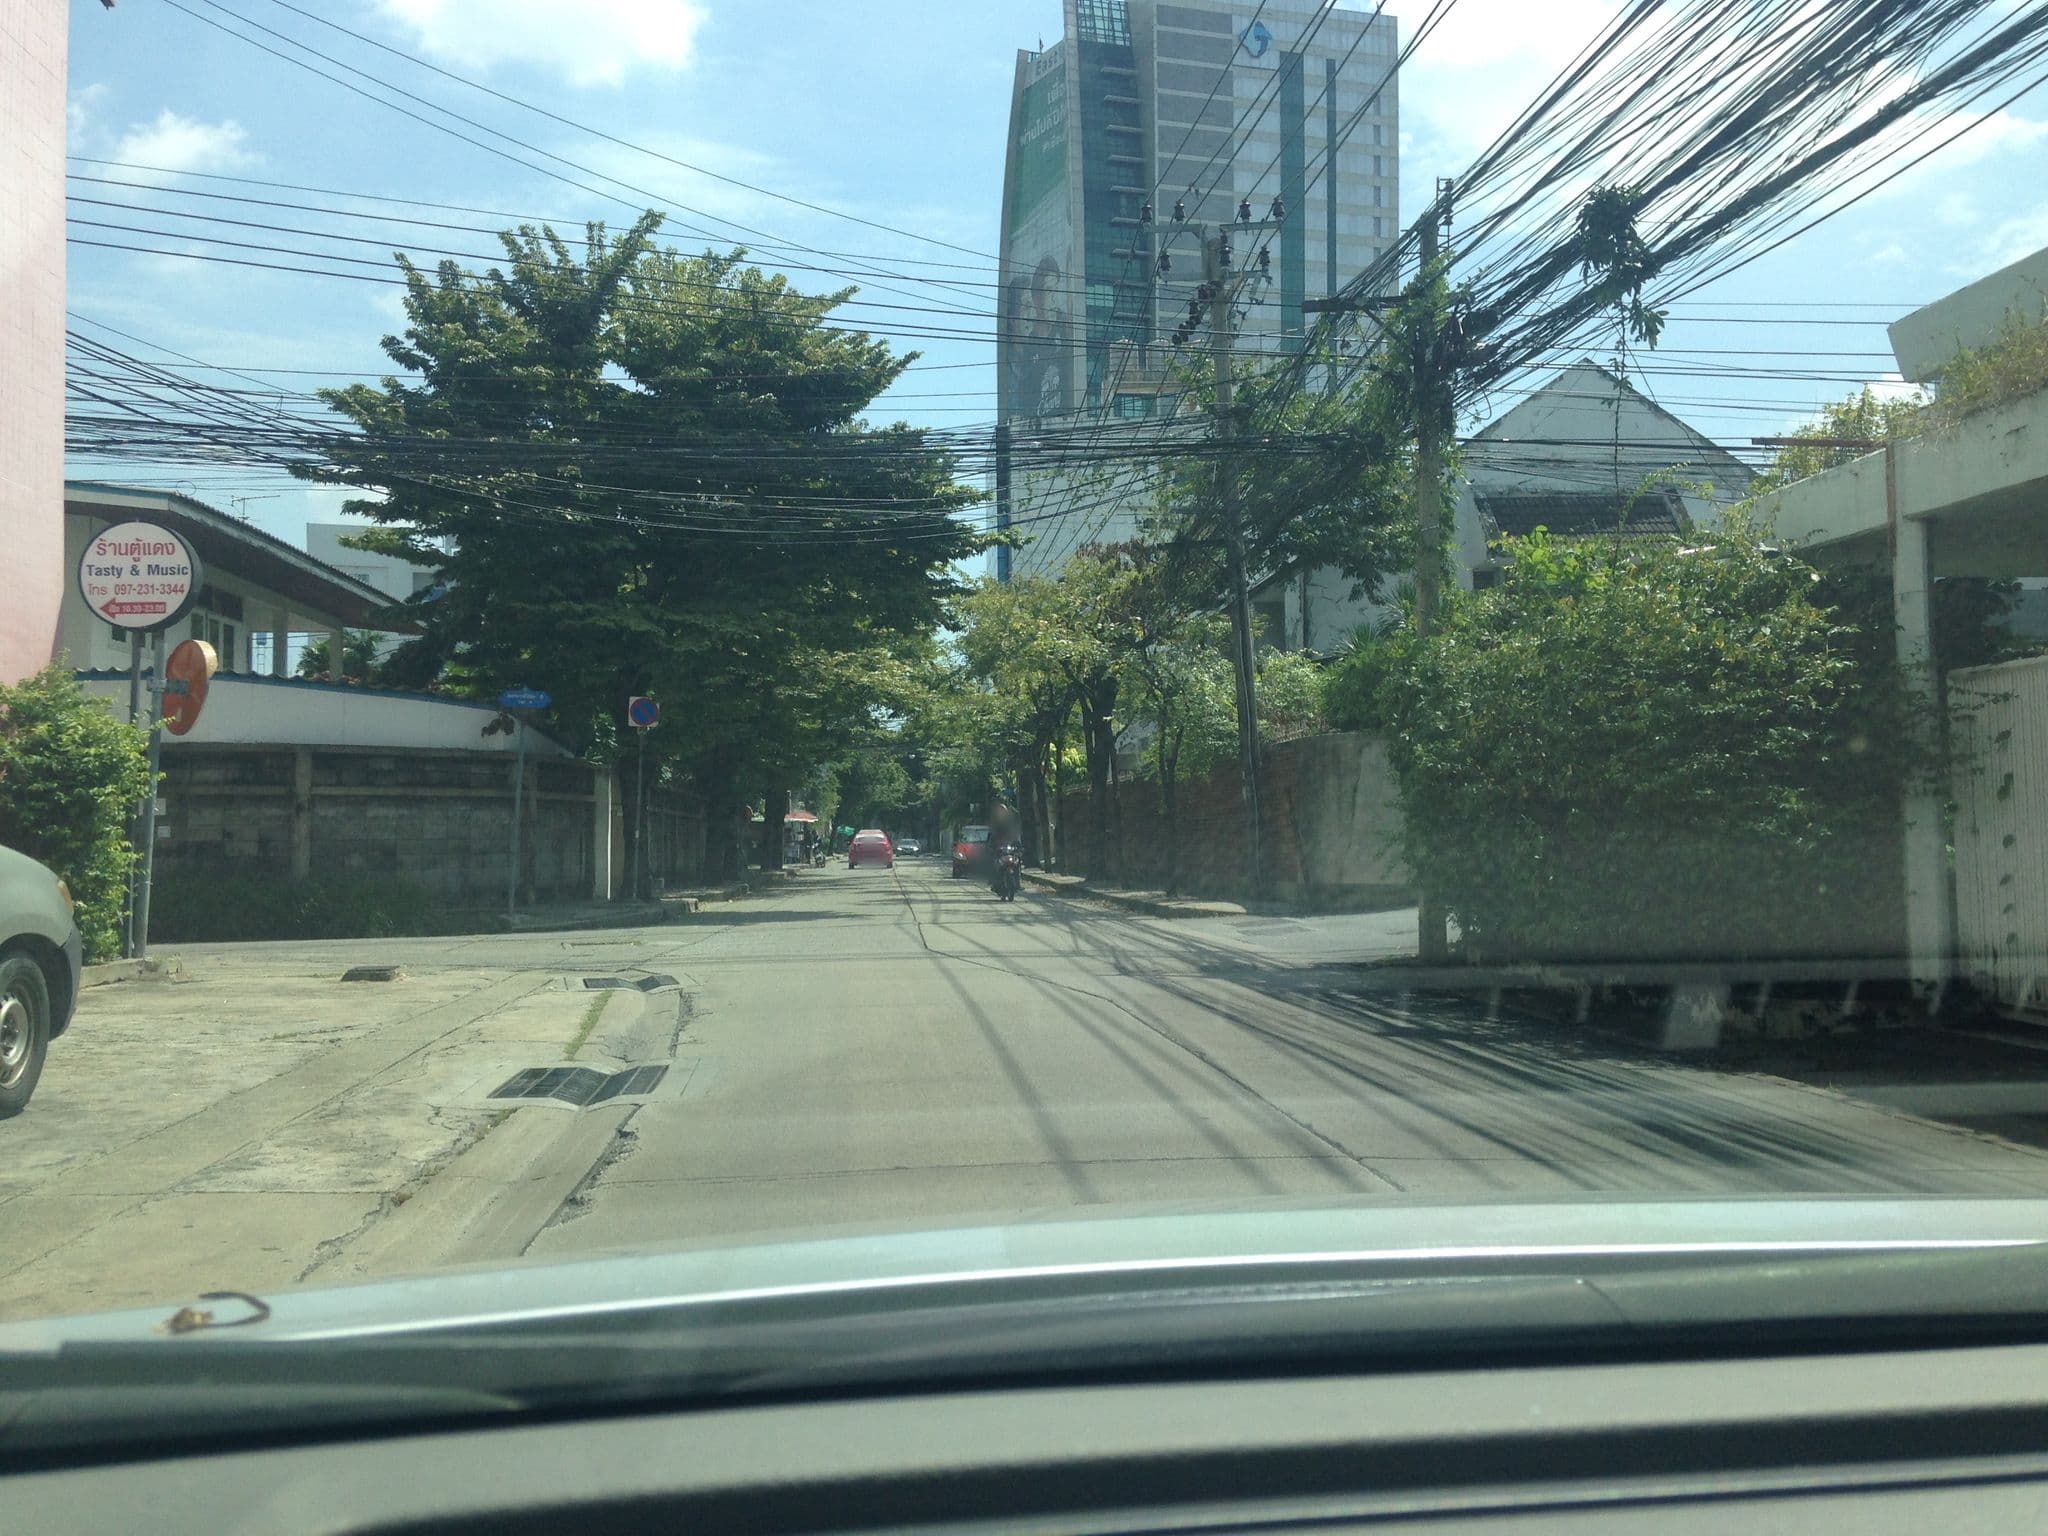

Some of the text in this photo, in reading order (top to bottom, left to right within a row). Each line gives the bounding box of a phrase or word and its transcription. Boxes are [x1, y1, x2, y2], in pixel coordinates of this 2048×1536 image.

[96, 538, 176, 562] ร้านตู้แดง
[86, 564, 189, 578] Tasty & Music
[114, 583, 185, 595] 097-231-3344
